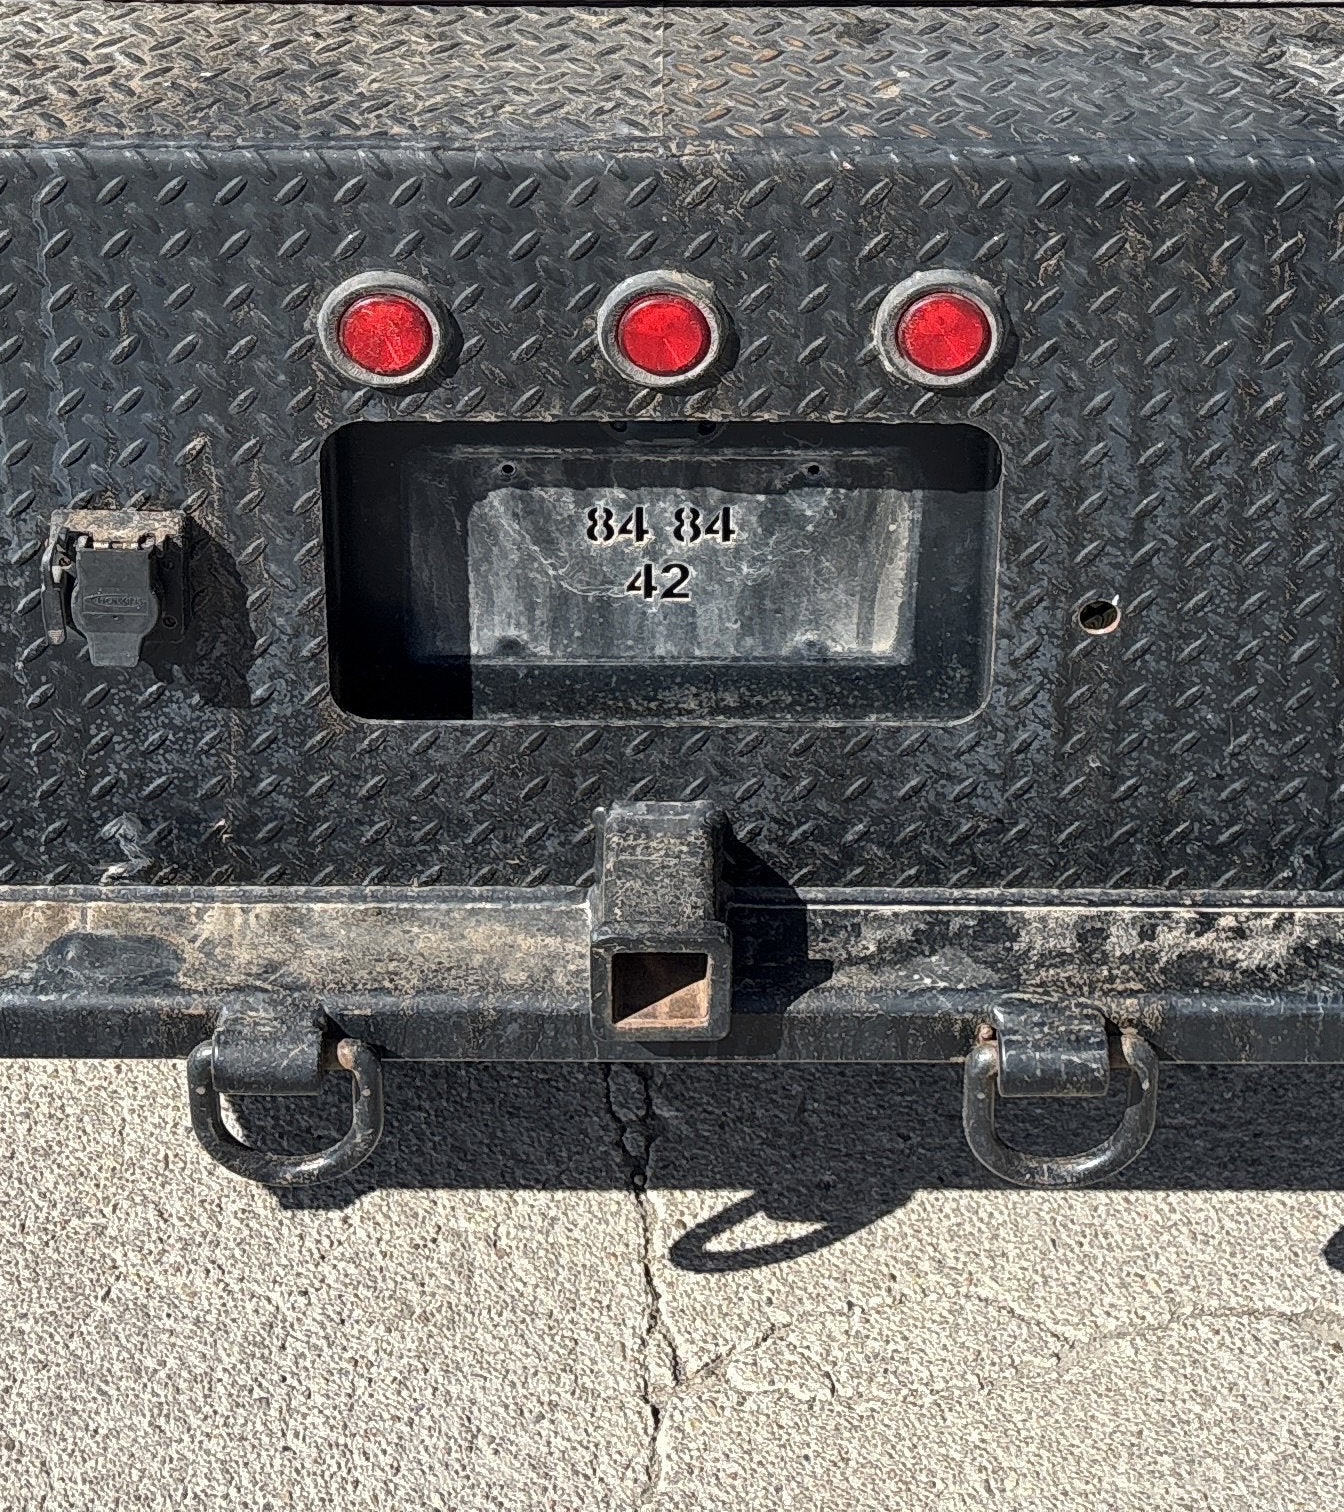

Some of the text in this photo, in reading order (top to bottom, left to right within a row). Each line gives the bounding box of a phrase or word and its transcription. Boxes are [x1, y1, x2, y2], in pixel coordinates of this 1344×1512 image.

[585, 506, 736, 543] 84 84
[625, 563, 691, 600] 42
